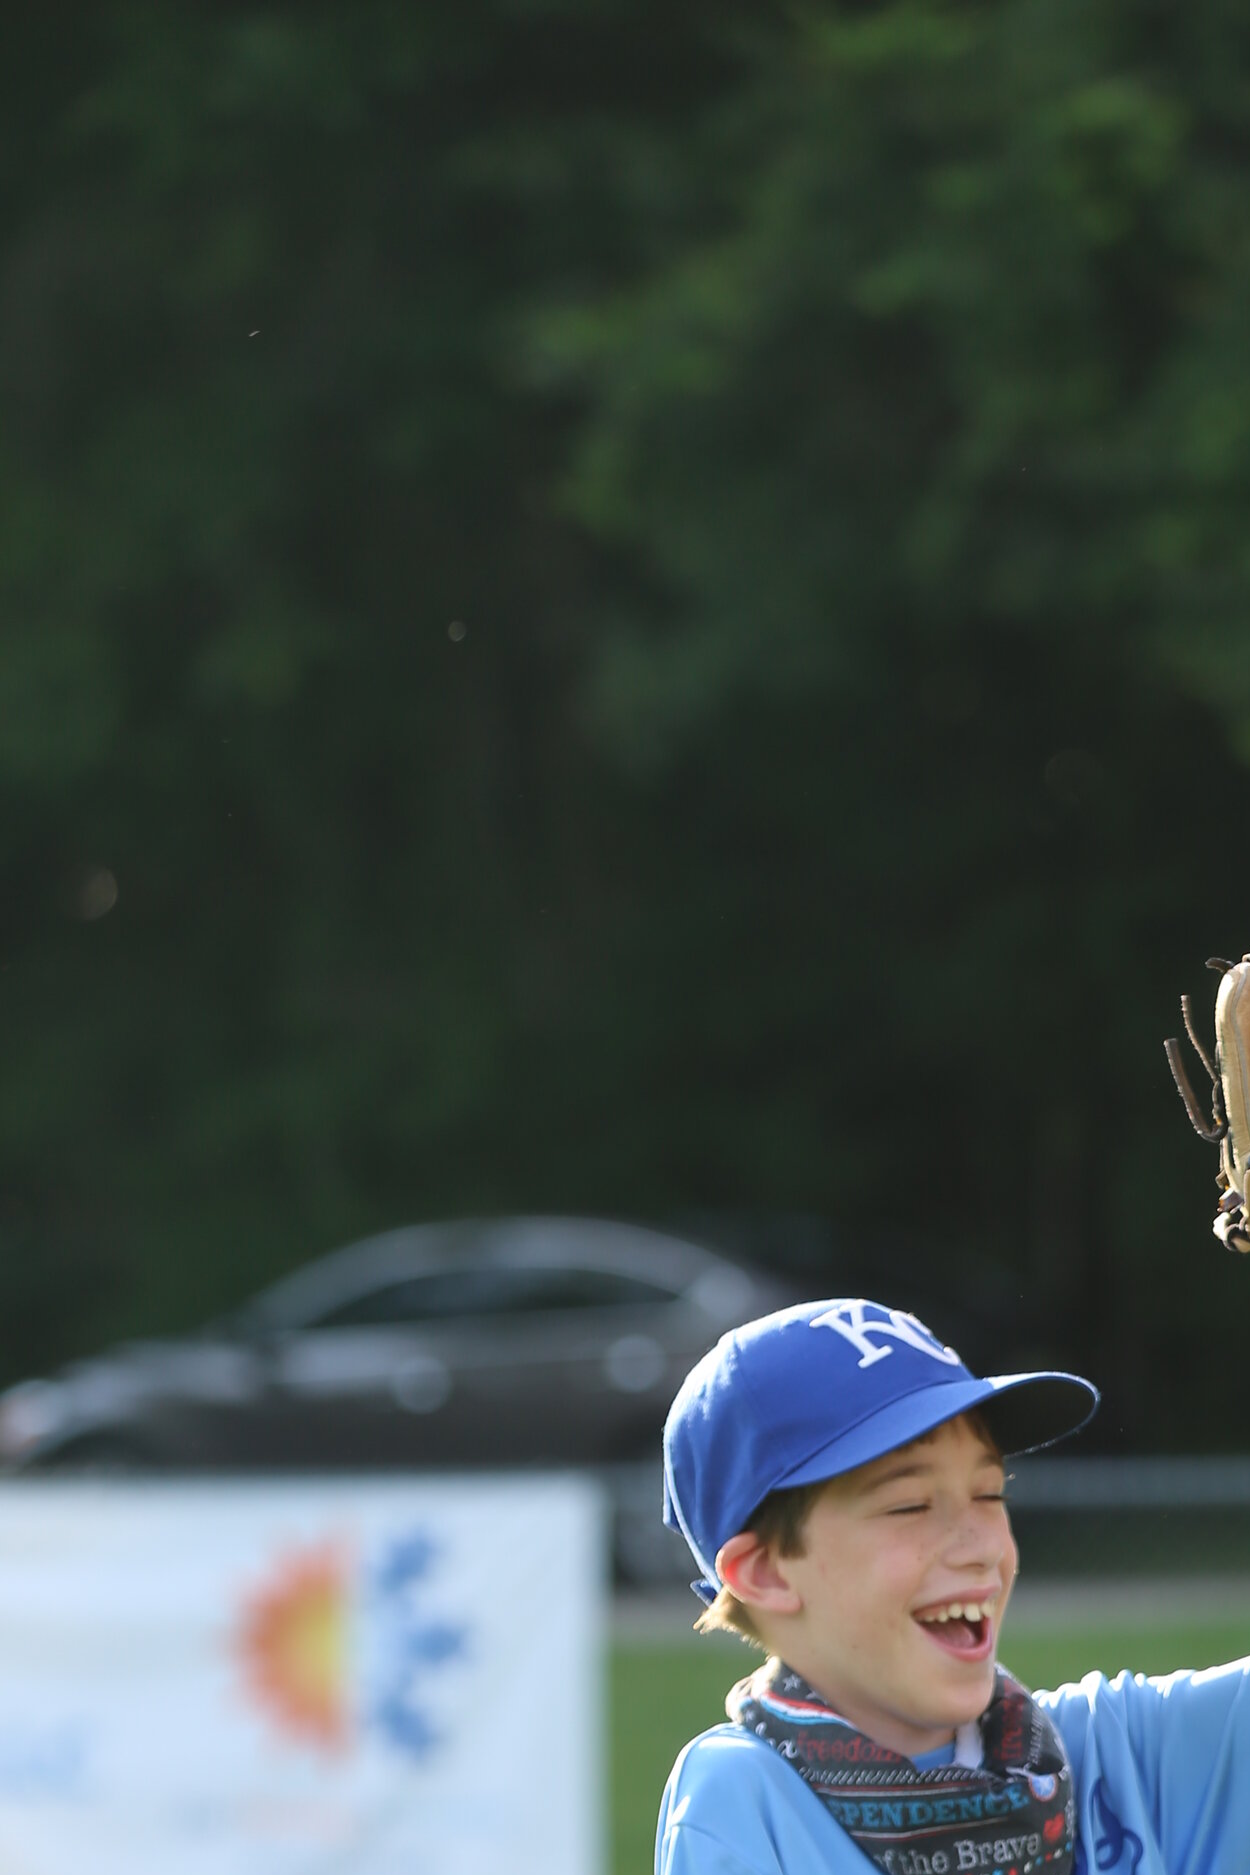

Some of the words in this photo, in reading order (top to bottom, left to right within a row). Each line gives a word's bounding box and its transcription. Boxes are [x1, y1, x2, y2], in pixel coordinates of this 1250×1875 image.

[809, 1299, 959, 1368] KC
[797, 1731, 904, 1763] freedom
[898, 1847, 949, 1875] the
[954, 1833, 1040, 1871] Brave
